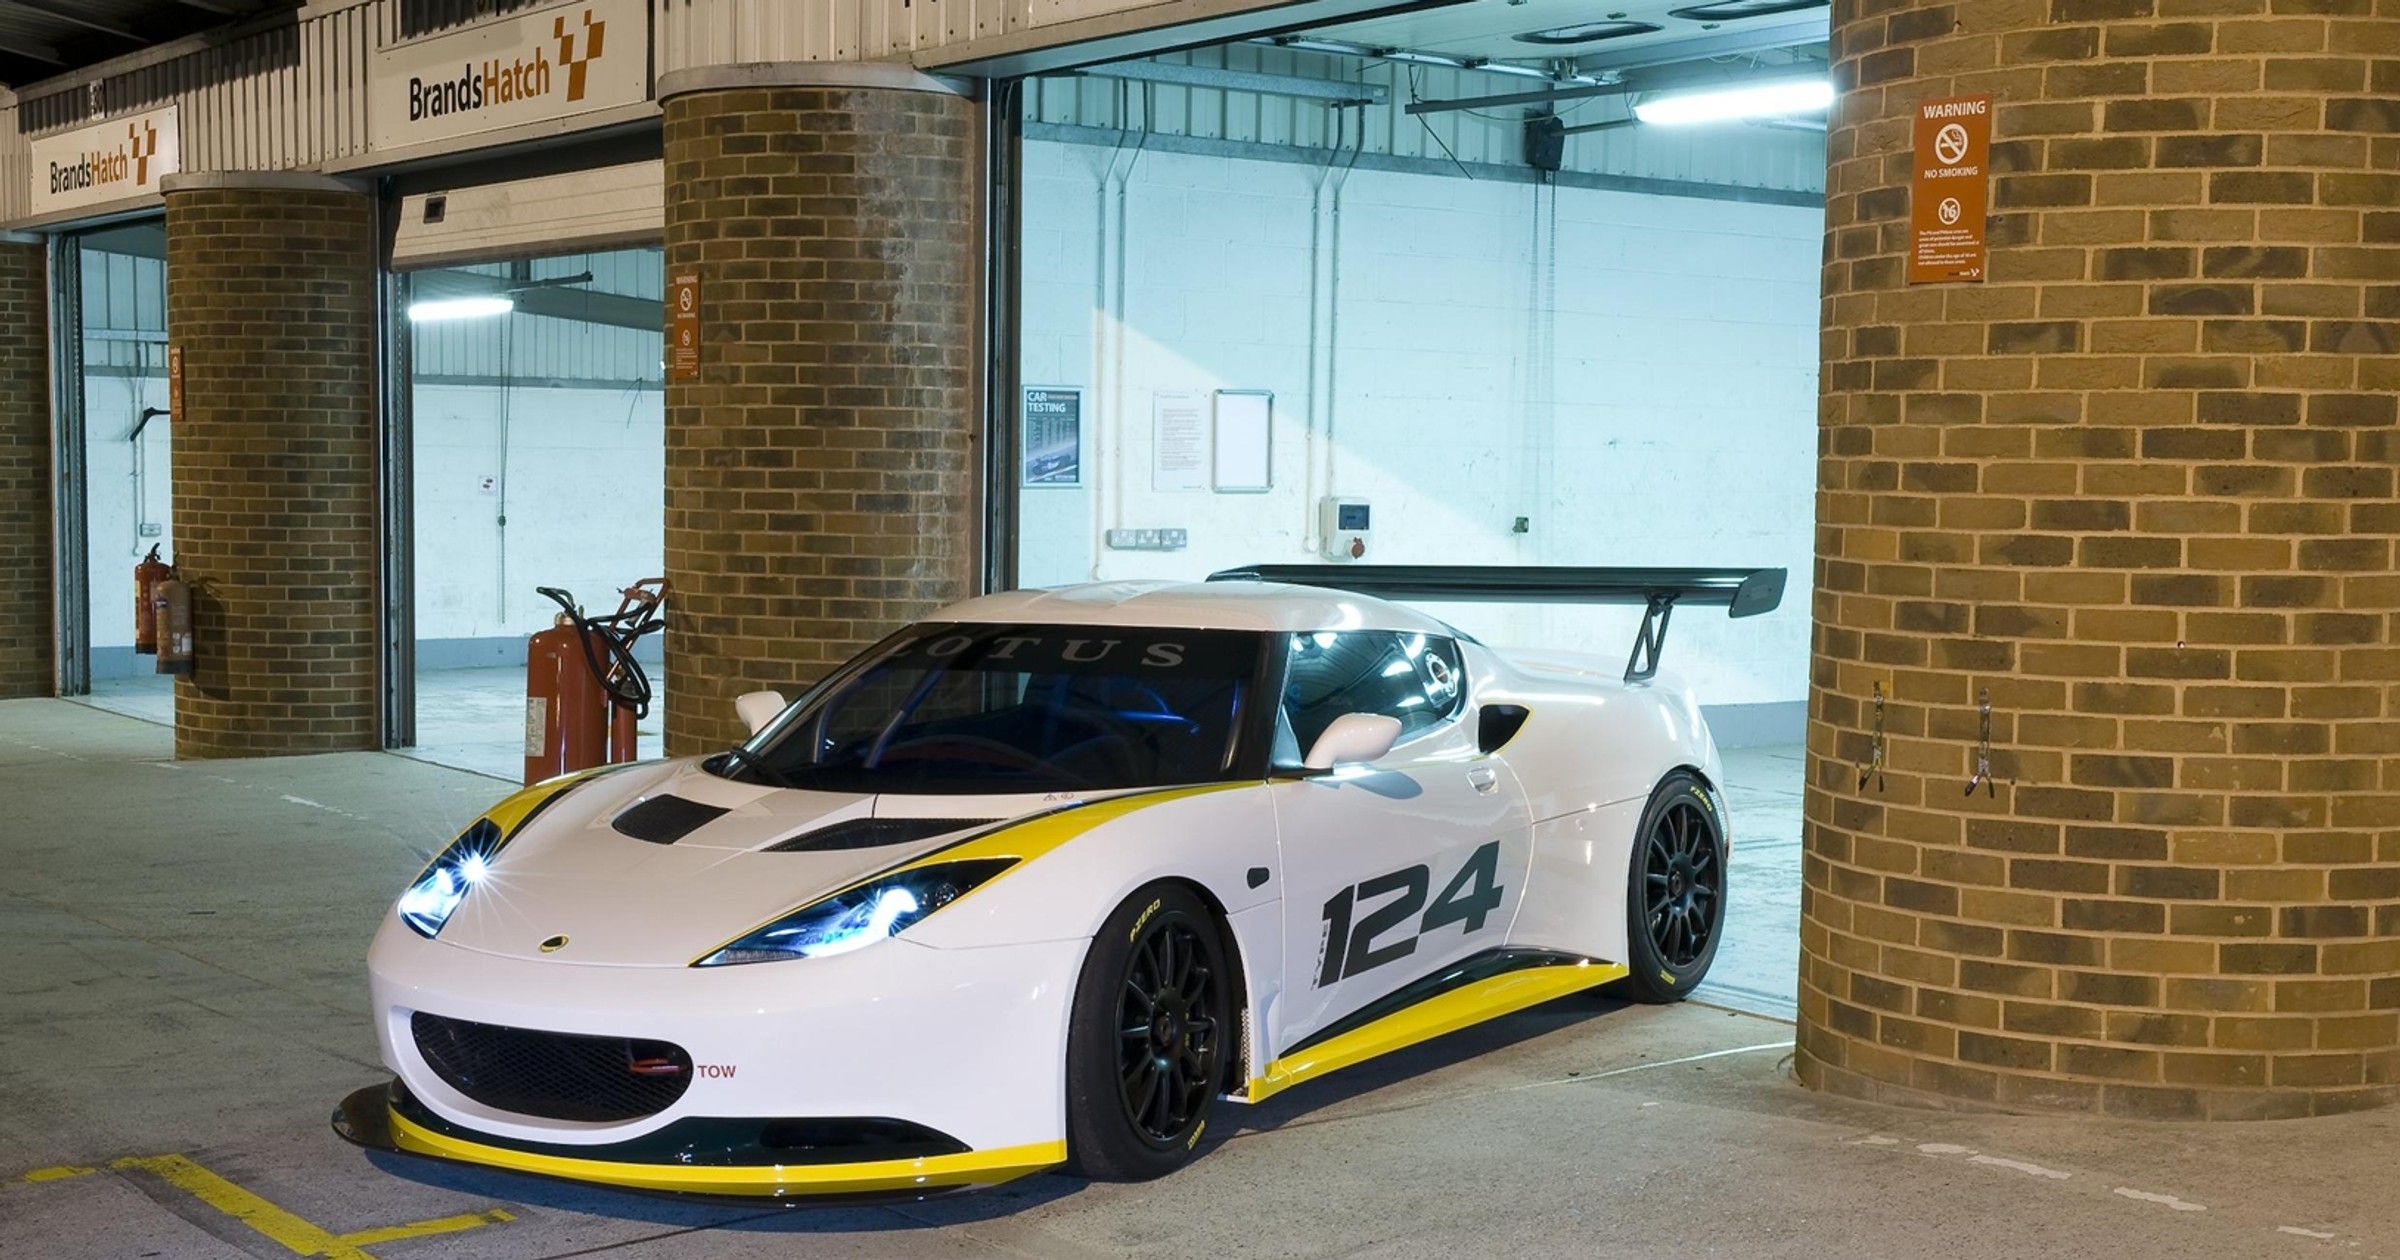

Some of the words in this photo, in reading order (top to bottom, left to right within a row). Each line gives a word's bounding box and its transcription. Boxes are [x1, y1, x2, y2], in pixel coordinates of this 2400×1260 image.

[410, 46, 550, 121] BrandsHatch
[1923, 100, 1986, 119] WARNING
[50, 143, 128, 194] BrandsHatch
[1924, 169, 1938, 179] NO
[1938, 166, 1978, 178] SMOKING
[1027, 392, 1048, 402] CAR
[1027, 402, 1067, 413] TESTING
[1318, 840, 1504, 988] 124
[697, 1065, 737, 1079] TOW
